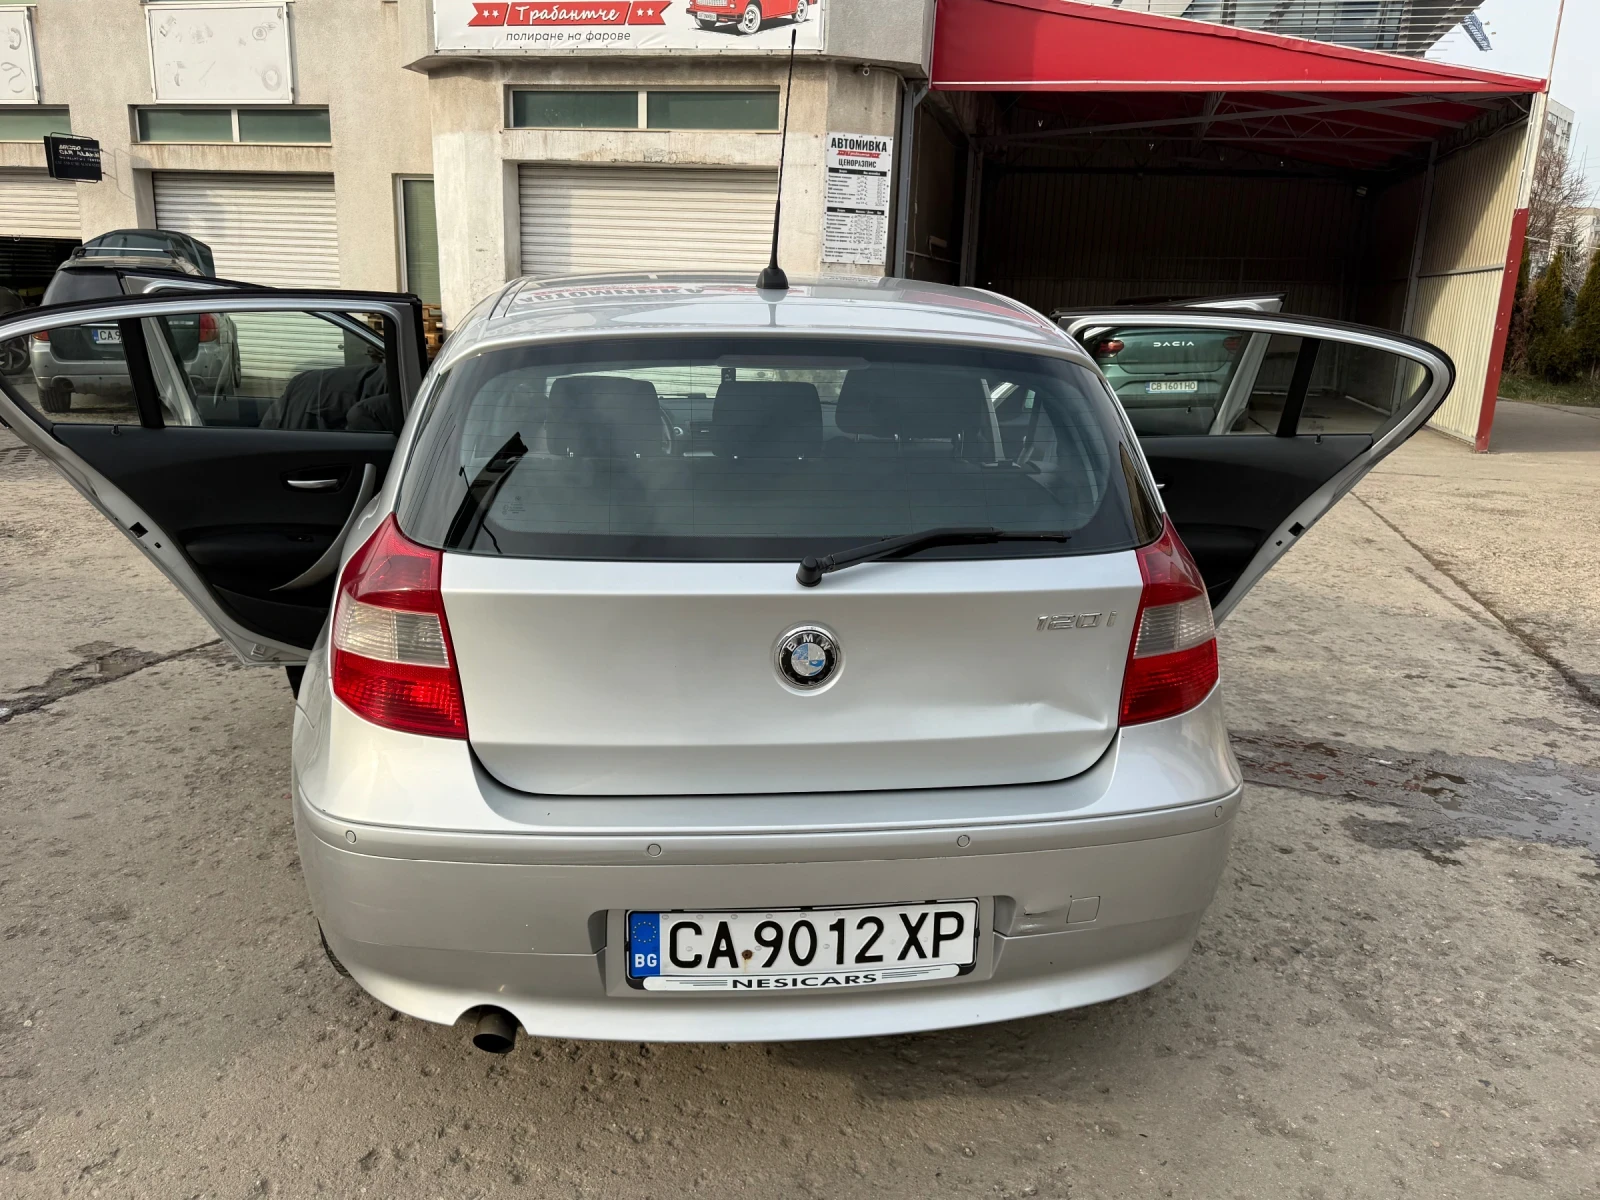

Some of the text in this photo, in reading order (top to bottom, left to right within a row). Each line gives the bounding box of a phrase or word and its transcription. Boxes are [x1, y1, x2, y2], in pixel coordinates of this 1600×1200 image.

[515, 5, 620, 24] Трабантче
[506, 30, 631, 42] полиране на фарове
[831, 138, 887, 152] АВТОМИВКА
[839, 159, 876, 168] ЦЕНОРАЗПИС
[100, 331, 113, 340] CA
[1151, 382, 1162, 390] CB
[669, 911, 965, 969] CA 9012 XP
[634, 953, 657, 968] BG
[732, 973, 878, 989] NESICARS
